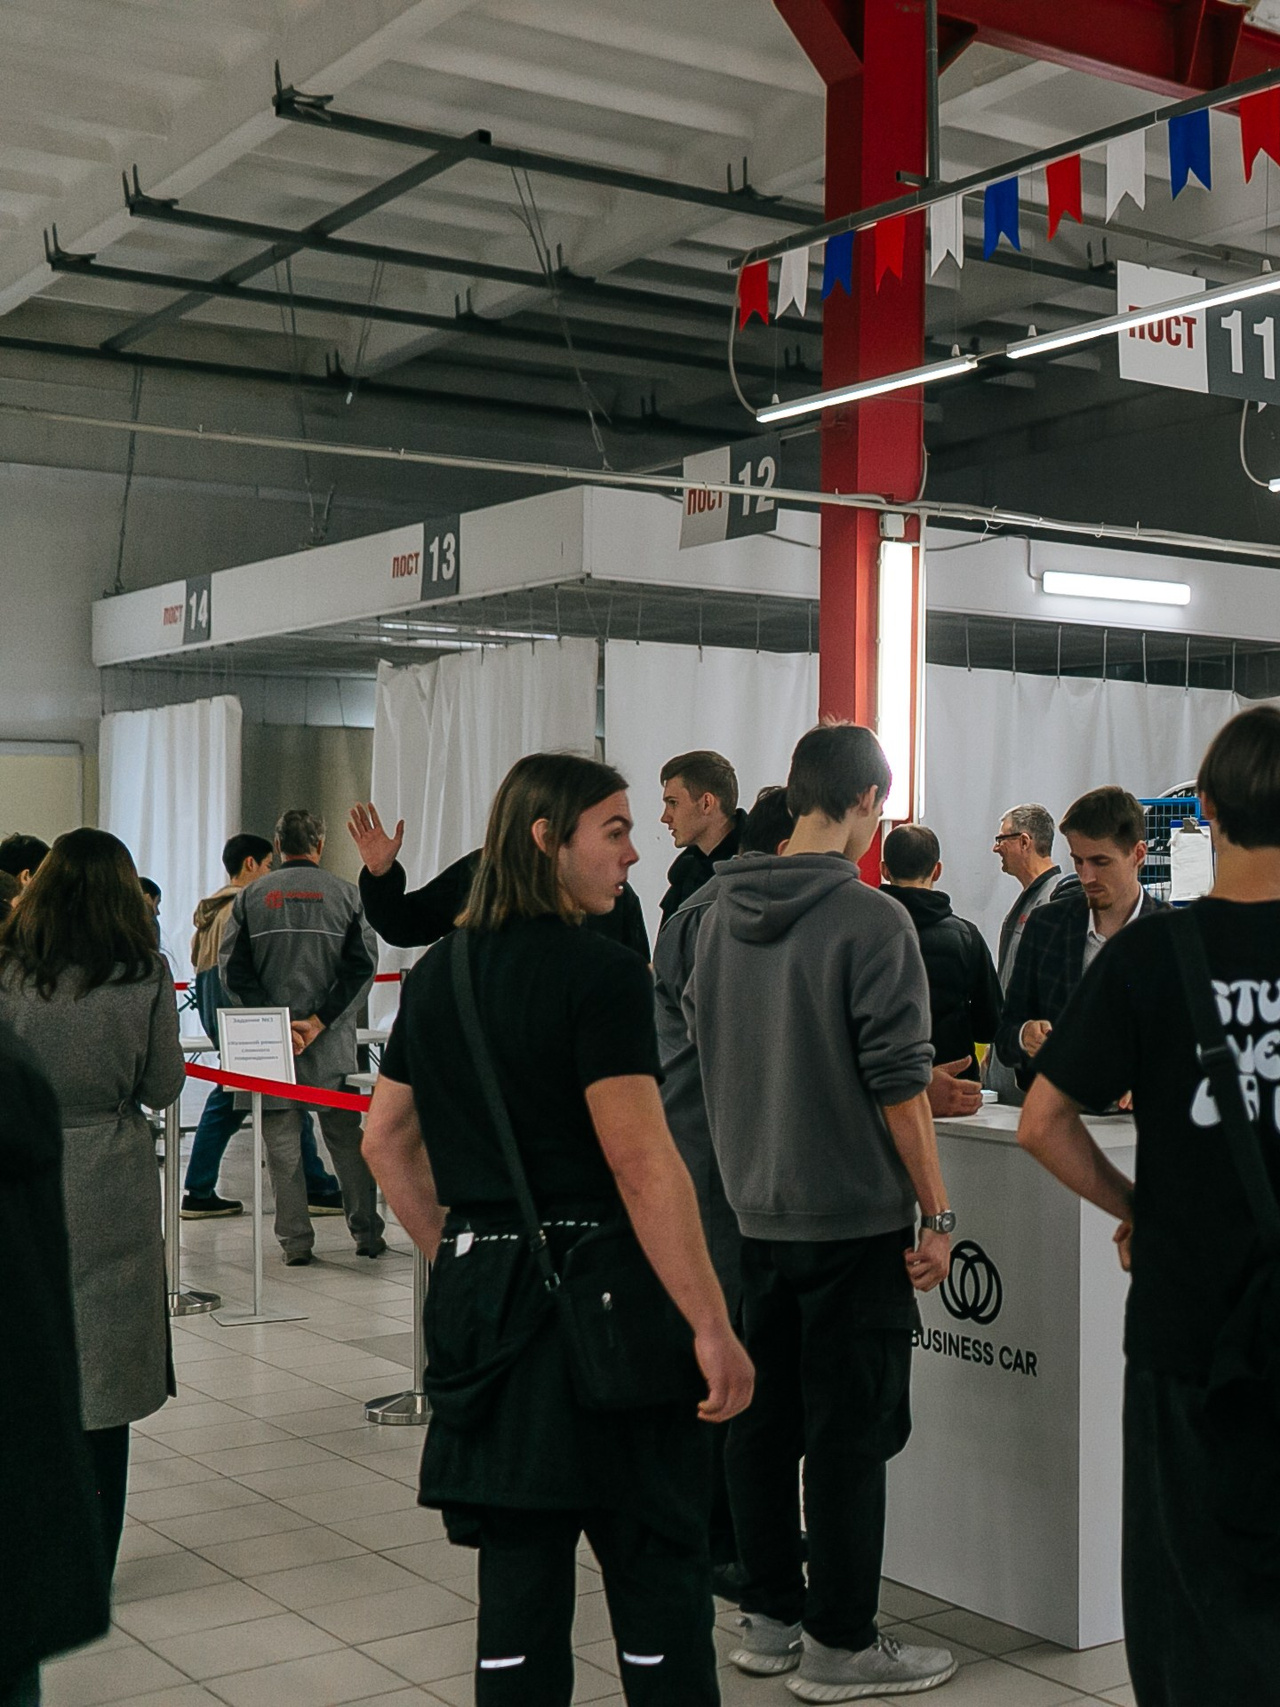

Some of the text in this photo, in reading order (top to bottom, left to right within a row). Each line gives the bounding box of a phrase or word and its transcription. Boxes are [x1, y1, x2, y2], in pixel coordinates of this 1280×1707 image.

[1221, 309, 1275, 380] 11
[738, 456, 775, 515] 12
[392, 532, 456, 582] ПОСТ 13
[189, 590, 208, 631] 14
[999, 1345, 1038, 1378] CAR
